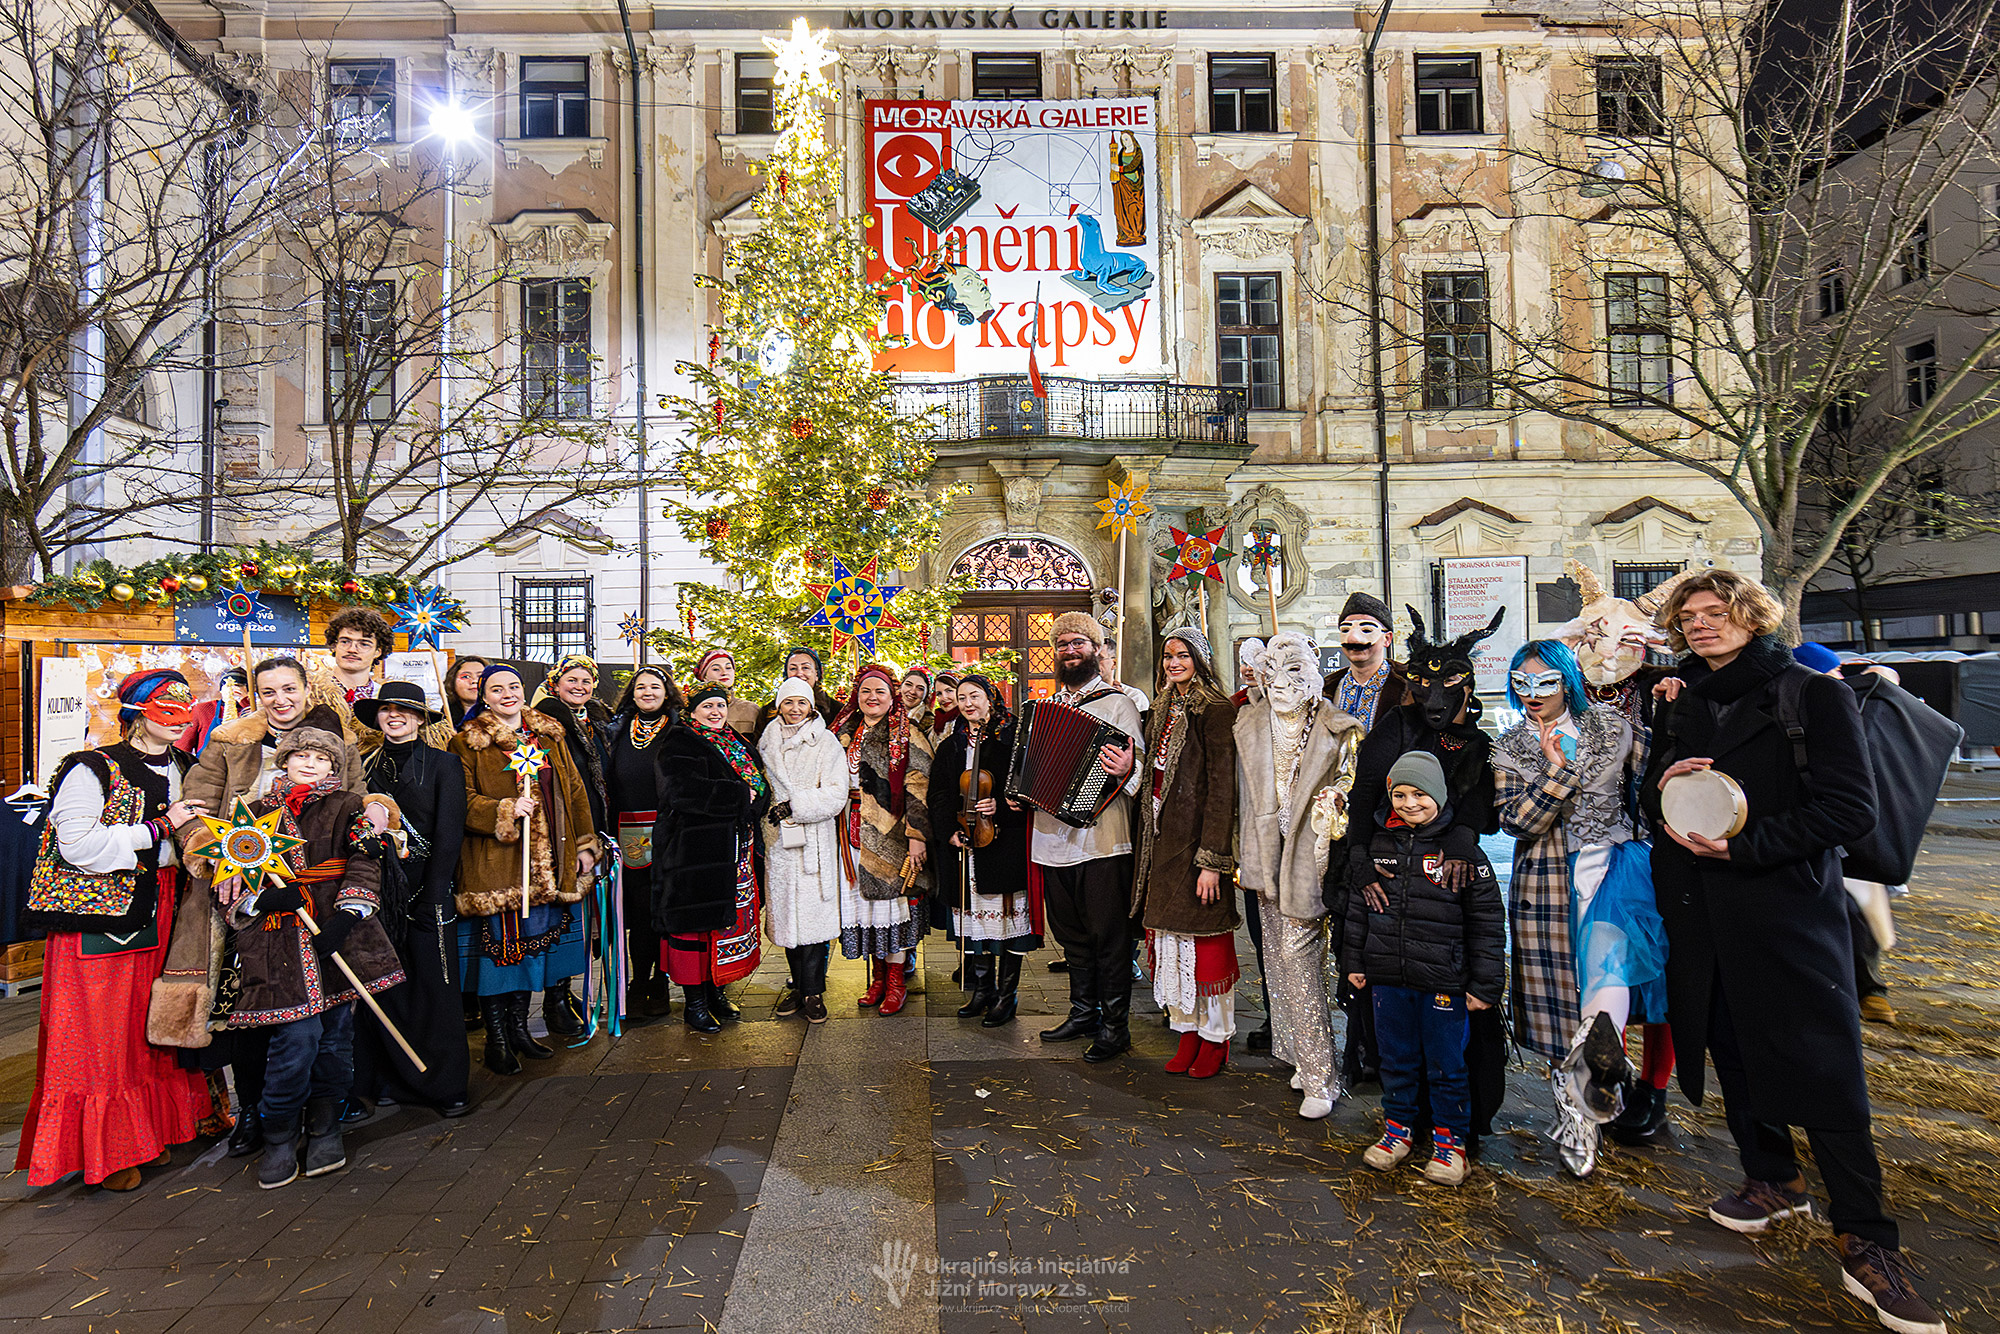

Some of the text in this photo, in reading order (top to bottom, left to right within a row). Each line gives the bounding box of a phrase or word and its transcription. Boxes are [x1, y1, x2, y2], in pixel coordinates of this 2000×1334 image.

[846, 6, 1167, 29] MORAVSKÁ GALERIE
[874, 105, 1148, 128] MORAVSKÁ GALERIE
[874, 203, 1082, 273] Umění
[877, 277, 1151, 367] do kapsy
[1447, 560, 1521, 569] MORAVSKÁ GALERIE
[215, 622, 277, 632] orgaizace
[47, 697, 75, 714] KULTINO
